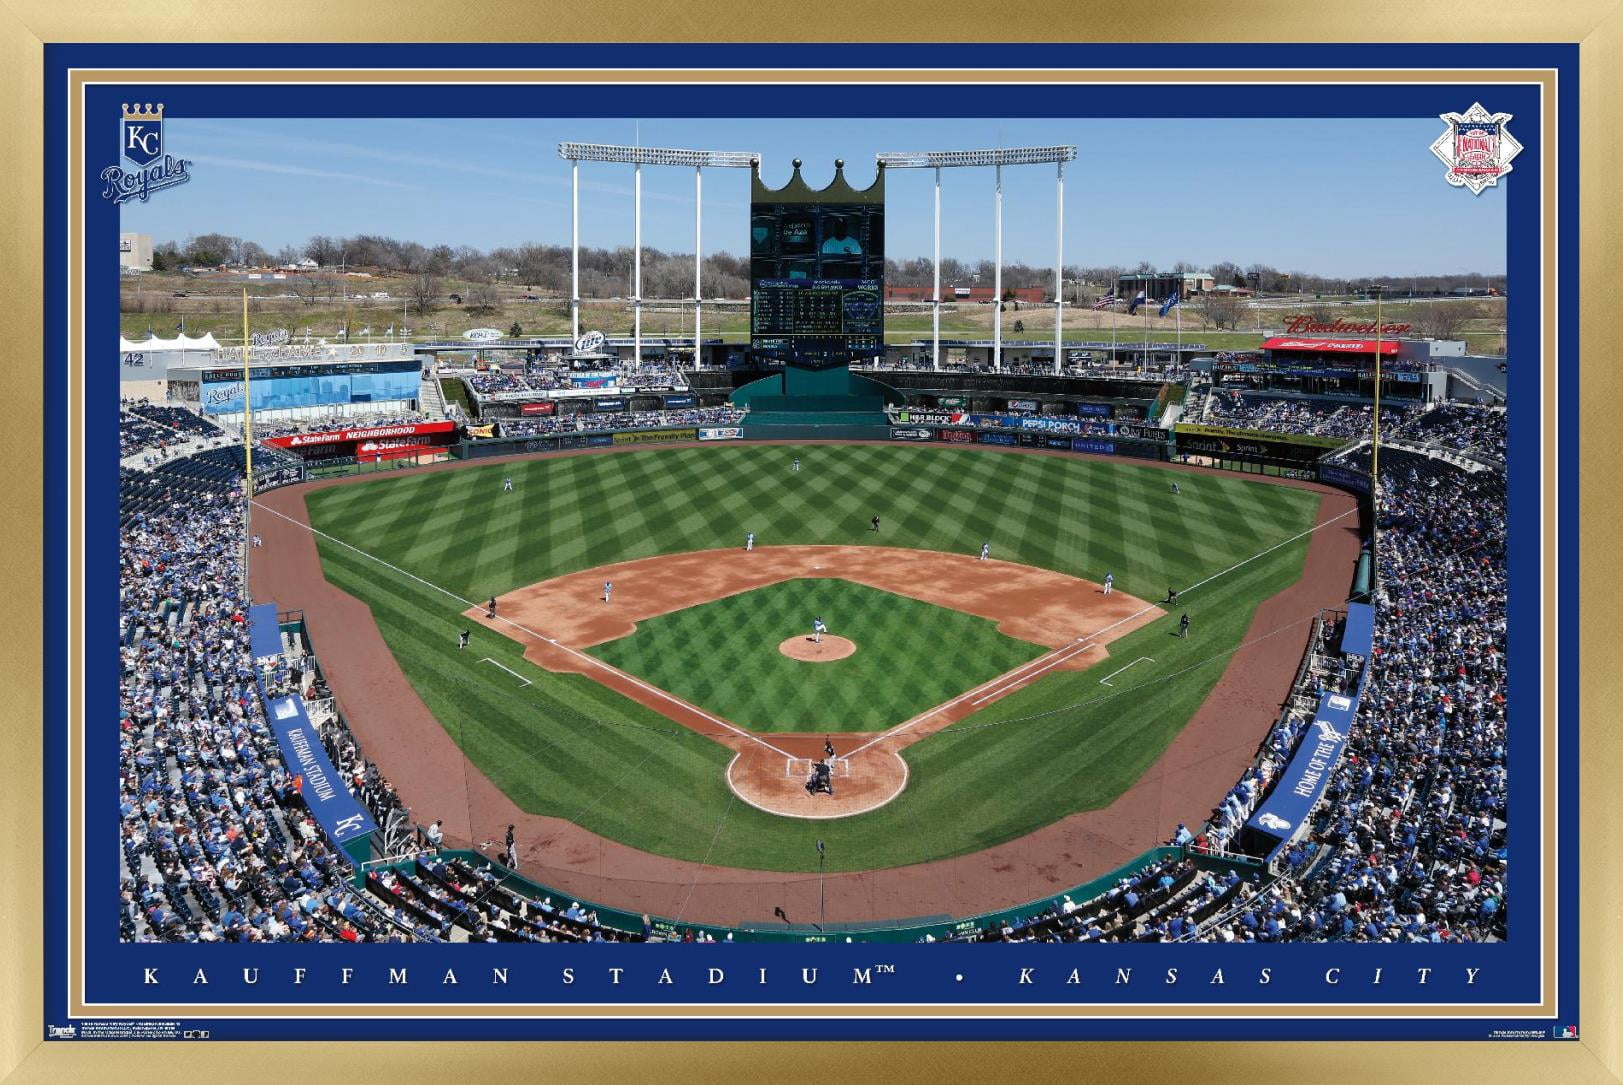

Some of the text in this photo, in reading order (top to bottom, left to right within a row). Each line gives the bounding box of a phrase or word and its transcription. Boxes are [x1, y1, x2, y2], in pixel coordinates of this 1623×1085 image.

[252, 328, 289, 346] Royals
[124, 352, 145, 367] 42
[346, 426, 416, 440] NEIGHBORHOOD
[1022, 419, 1080, 432] PEPSI PORCH
[1294, 742, 1335, 797] HOME OF THE
[304, 763, 337, 802] STADIUM
